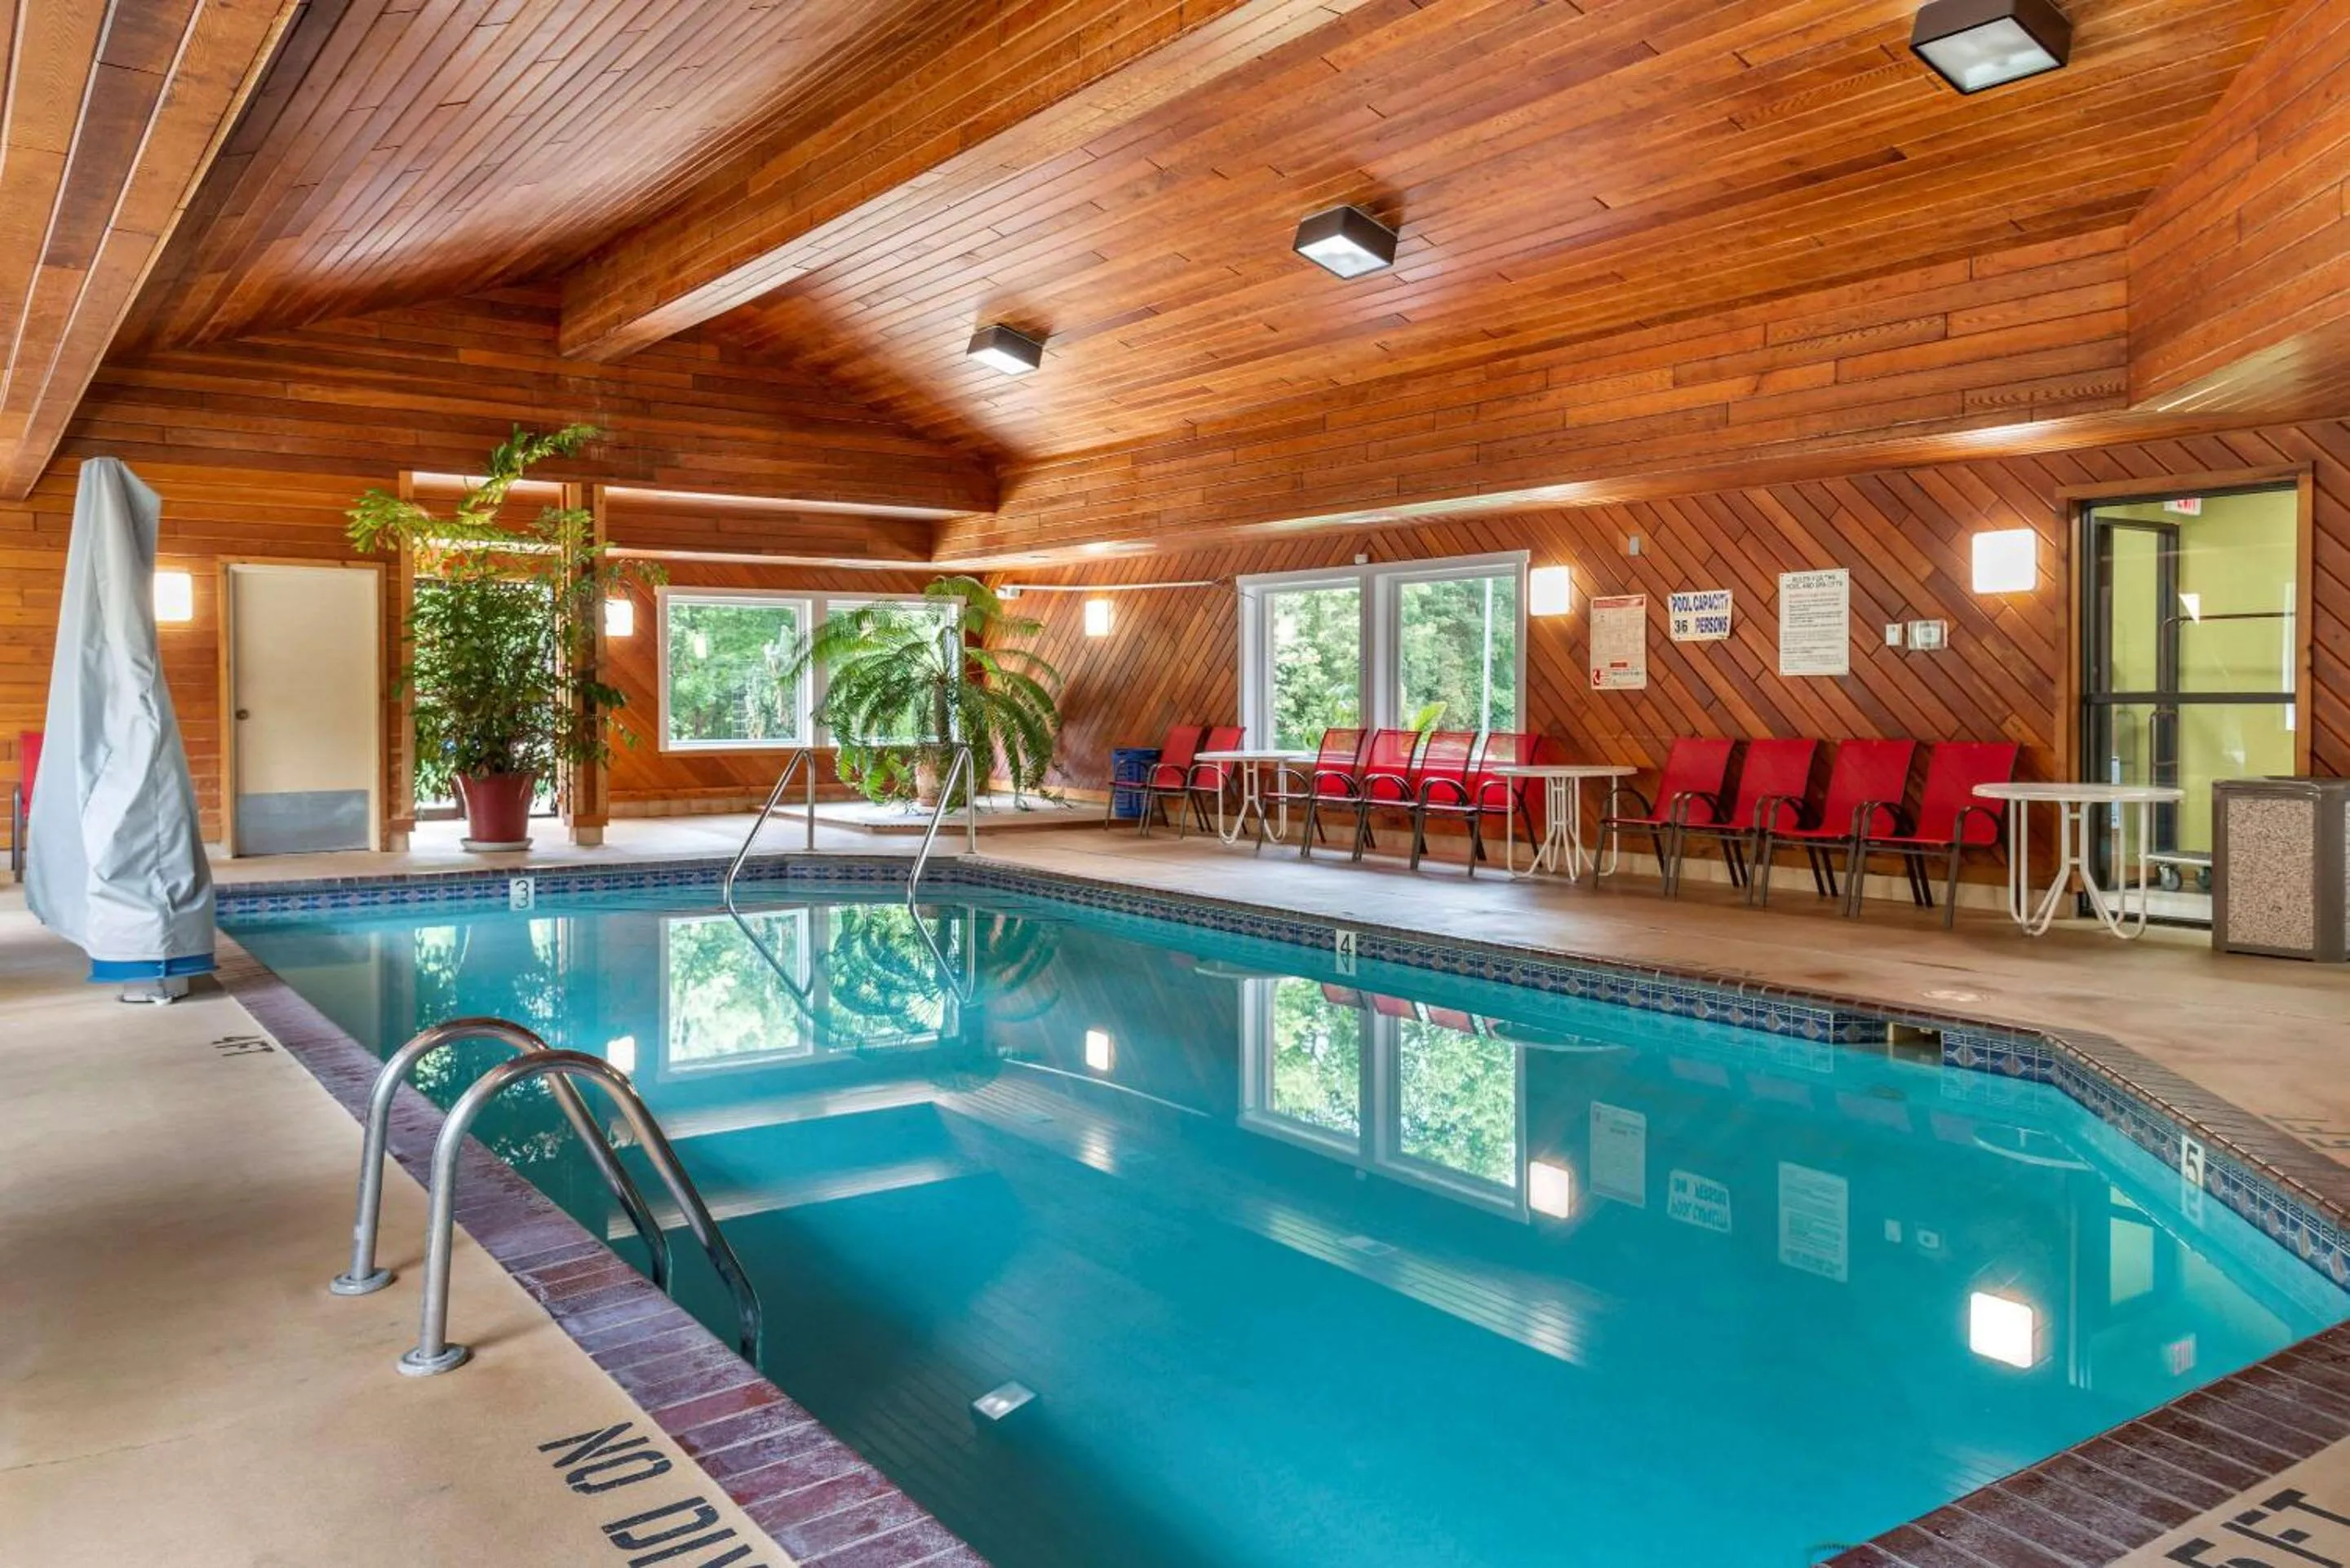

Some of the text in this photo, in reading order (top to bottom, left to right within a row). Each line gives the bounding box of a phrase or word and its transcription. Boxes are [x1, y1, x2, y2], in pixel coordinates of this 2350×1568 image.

[1671, 593, 1728, 612] POOL CAPACITY
[1674, 616, 1727, 634] 36 PERSONS
[515, 879, 529, 897] 3
[1341, 933, 1353, 955] 4
[2187, 1143, 2198, 1185] 5
[538, 1422, 672, 1495] NO
